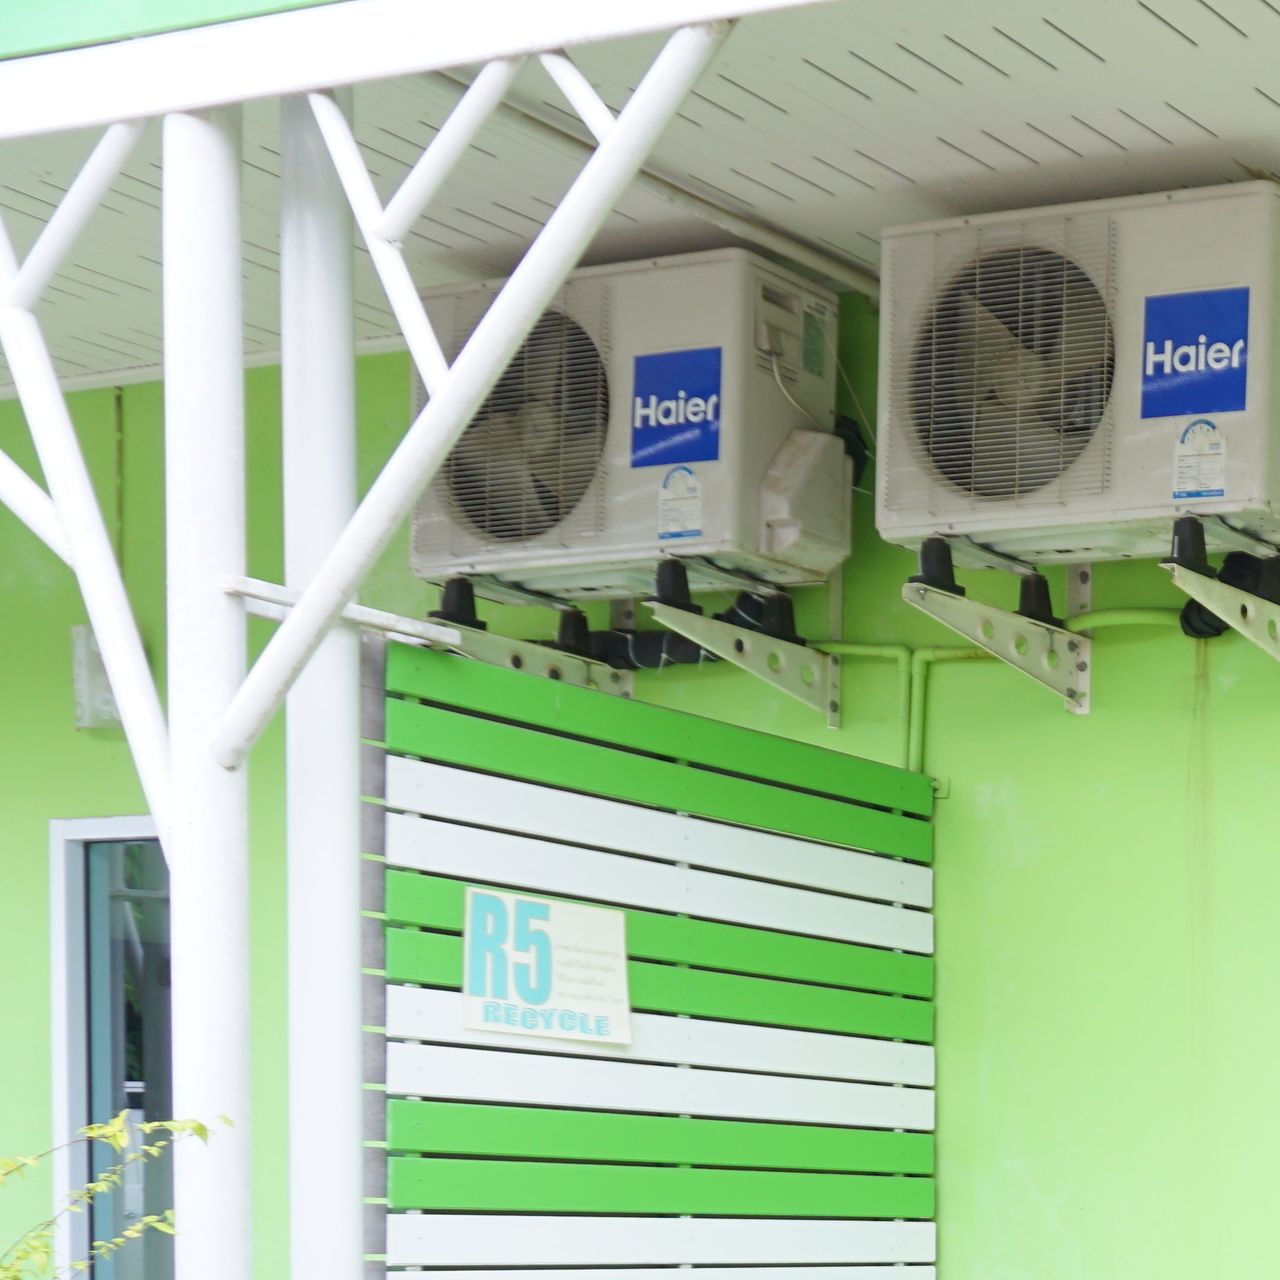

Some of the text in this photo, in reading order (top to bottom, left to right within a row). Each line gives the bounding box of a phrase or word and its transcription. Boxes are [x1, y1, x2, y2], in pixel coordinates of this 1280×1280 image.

[1146, 334, 1244, 376] Haier
[633, 390, 719, 429] Haier
[470, 892, 552, 1005] R5
[483, 1001, 610, 1036] RECYCLE
